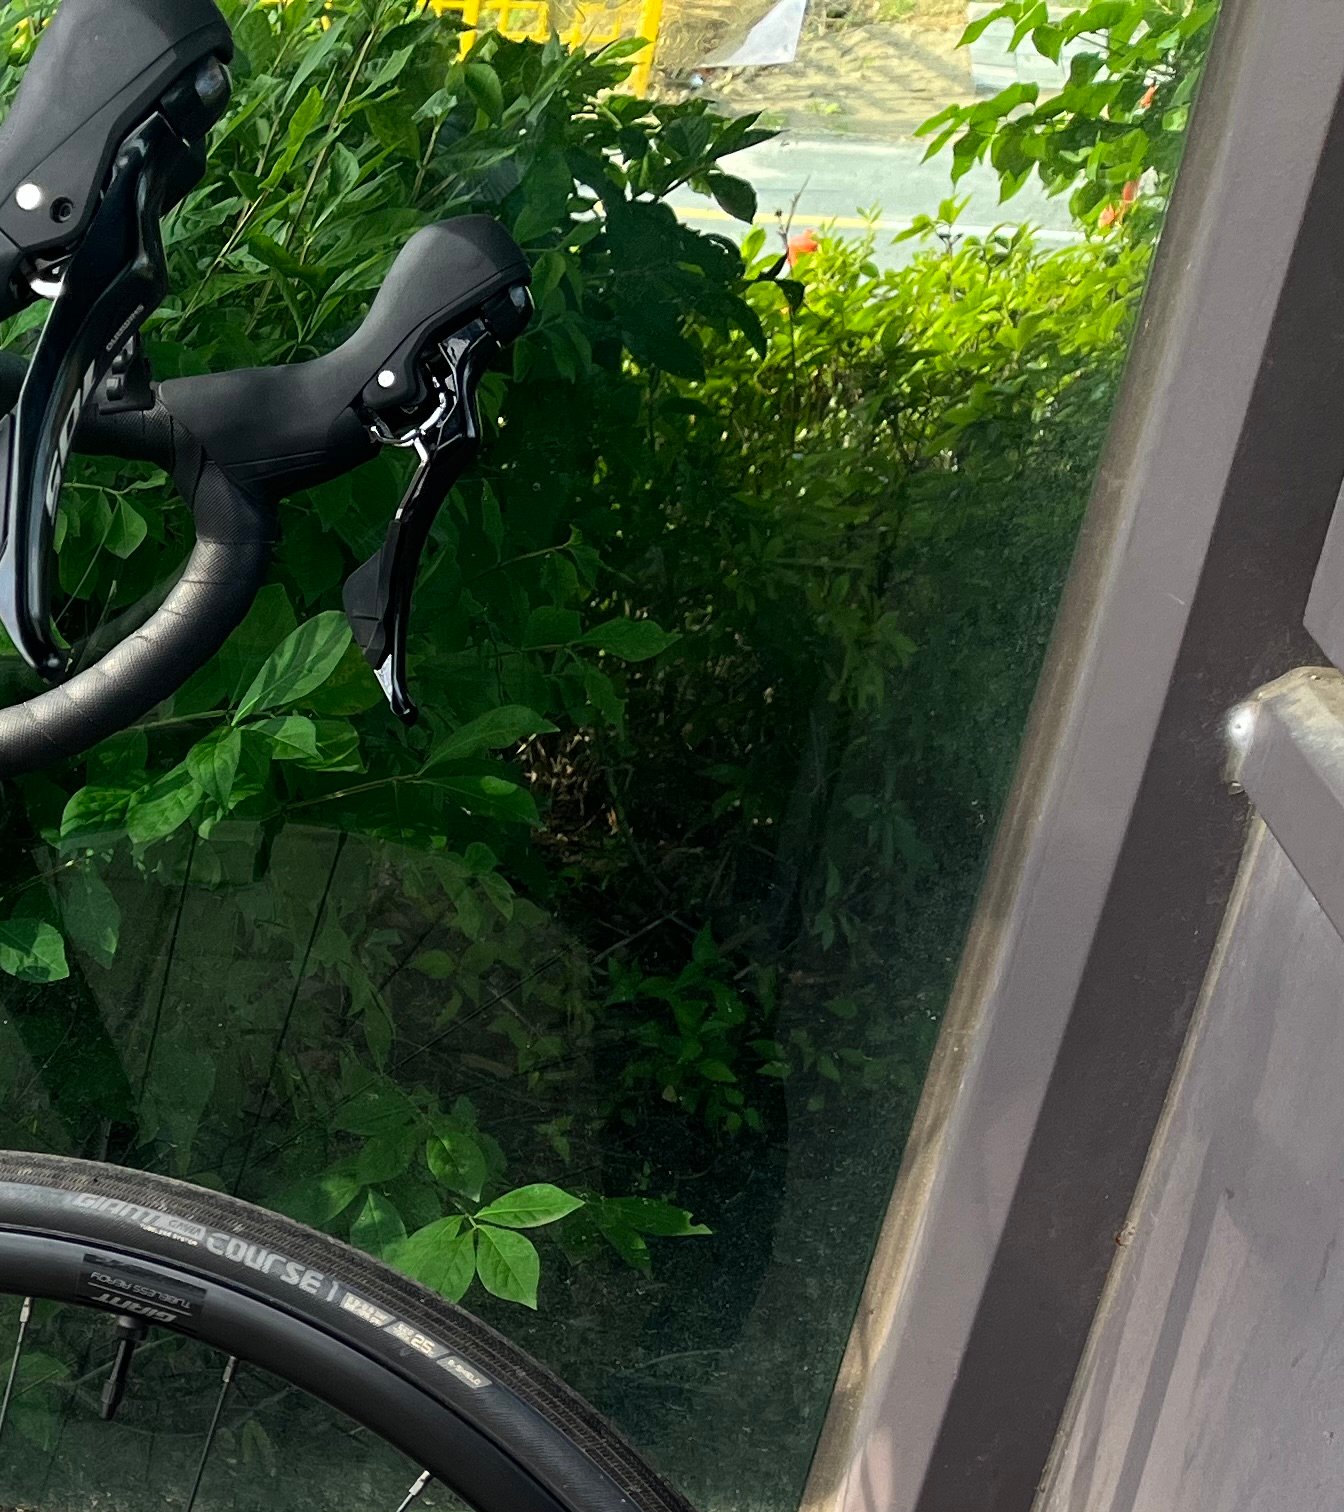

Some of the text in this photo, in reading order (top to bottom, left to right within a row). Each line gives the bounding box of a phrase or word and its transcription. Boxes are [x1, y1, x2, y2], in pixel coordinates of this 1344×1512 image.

[206, 1232, 324, 1296] COURSE
[89, 1270, 192, 1310] TUBELESS READY
[91, 1293, 177, 1323] GIANT
